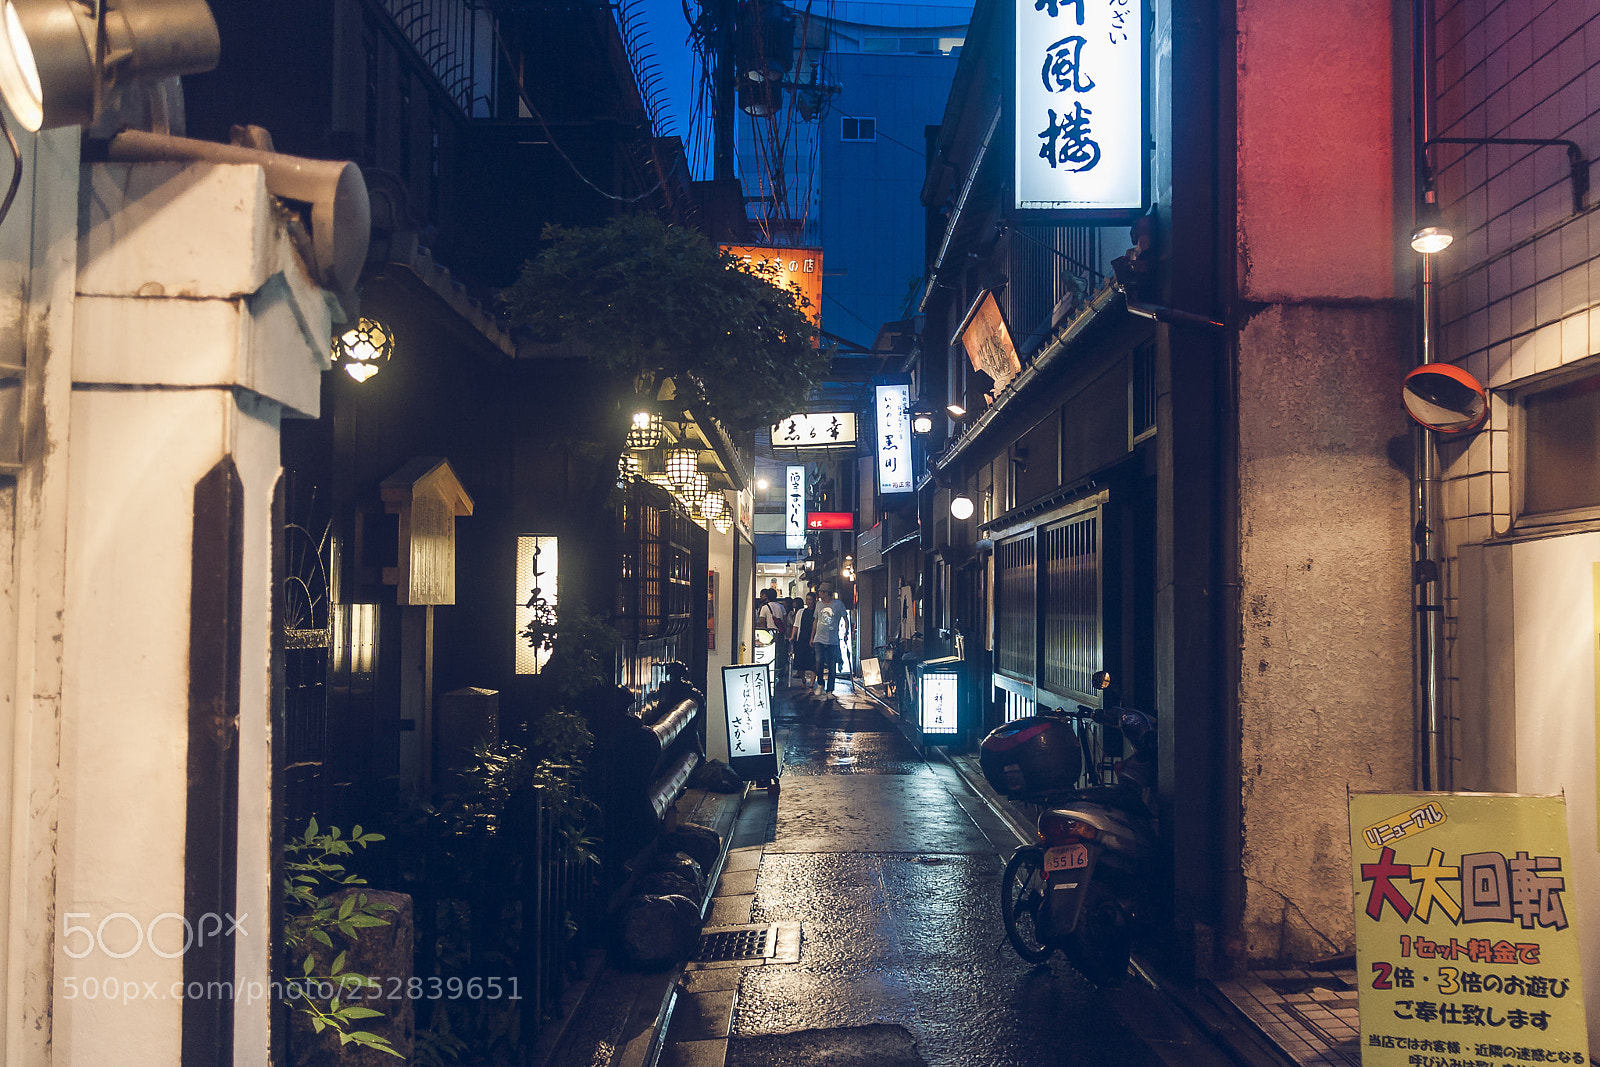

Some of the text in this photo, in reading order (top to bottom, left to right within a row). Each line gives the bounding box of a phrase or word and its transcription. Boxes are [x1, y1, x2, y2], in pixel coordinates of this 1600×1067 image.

[732, 716, 746, 752] さかえ
[1366, 804, 1443, 845] リニューアル
[1053, 853, 1084, 868] 5516
[1360, 845, 1569, 931] 大大回転
[1400, 934, 1541, 965] 1セット料金で
[1372, 962, 1570, 998] 2倍・3倍のお遊び
[1393, 1000, 1551, 1031] ご奉仕致します
